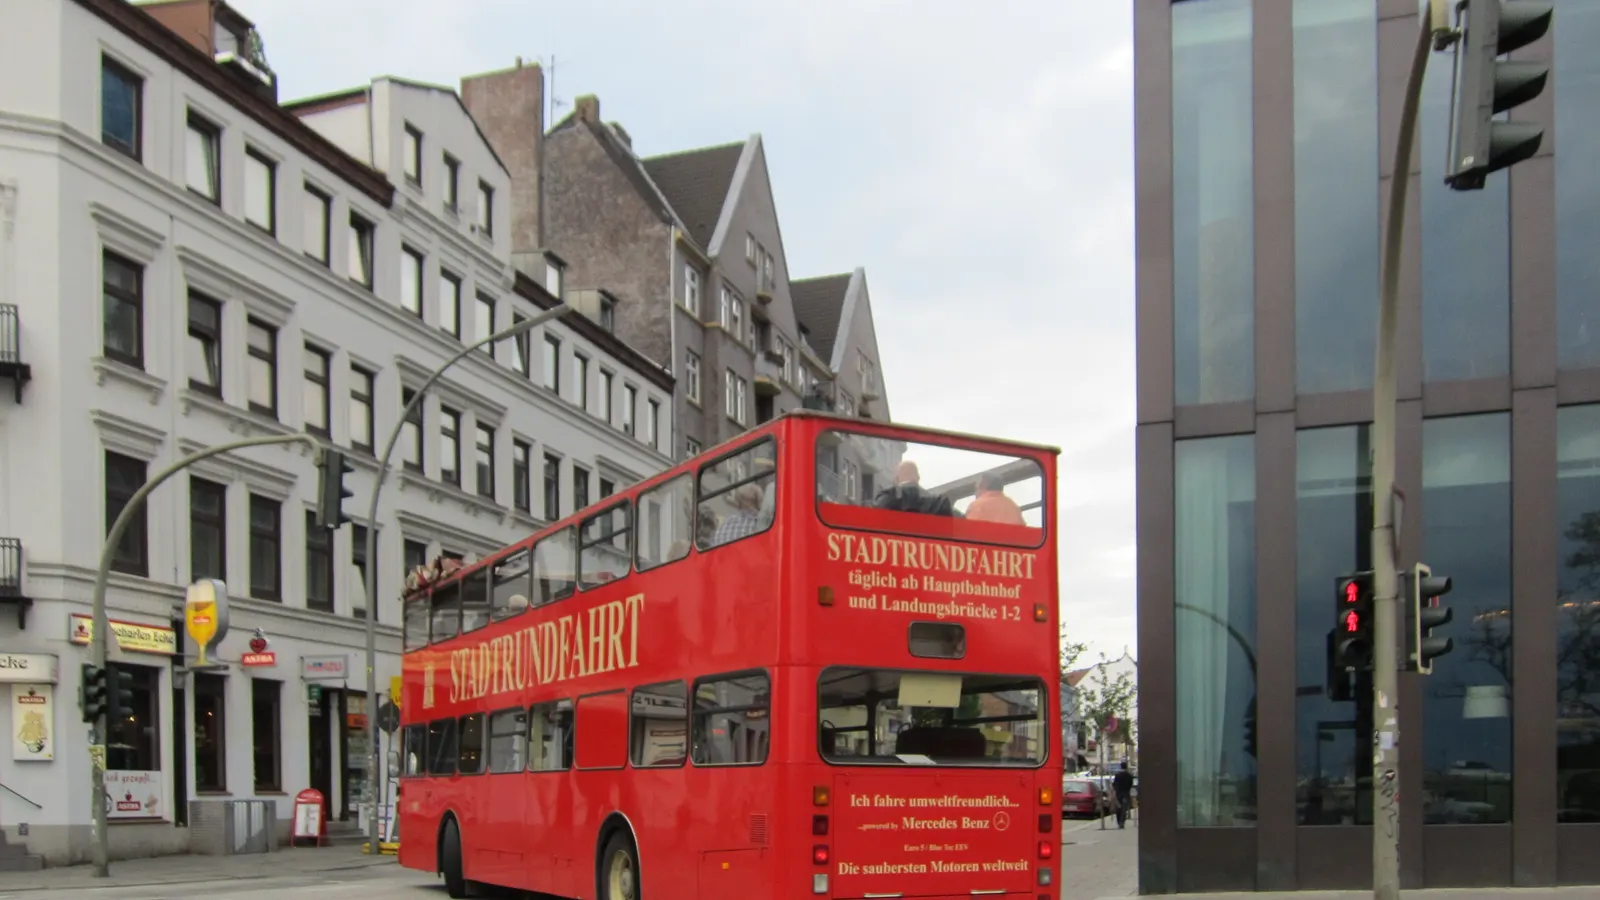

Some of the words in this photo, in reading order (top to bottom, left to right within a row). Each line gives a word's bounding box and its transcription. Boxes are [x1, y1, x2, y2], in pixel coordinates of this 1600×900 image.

[827, 532, 1036, 579] STADTRUNDFAHRT
[848, 569, 897, 590] täglich
[901, 574, 919, 590] ab
[923, 576, 1021, 600] Hauptbahnhof
[848, 594, 877, 610] und
[881, 595, 998, 619] Landungsbrücke
[1001, 605, 1021, 621] 1-2
[450, 593, 645, 704] STADTRUNDFAHRT
[243, 654, 274, 664] ASTRA
[850, 794, 870, 807] Ich
[874, 794, 906, 807] fahre
[909, 795, 1020, 808] umweltfreundlich...
[902, 816, 958, 829] Mercedes
[962, 816, 989, 829] Benz
[903, 844, 920, 852] Euro
[838, 862, 860, 875] Die
[862, 861, 927, 875] saubersten
[930, 860, 980, 873] Motoren
[982, 859, 1028, 872] weltweit
